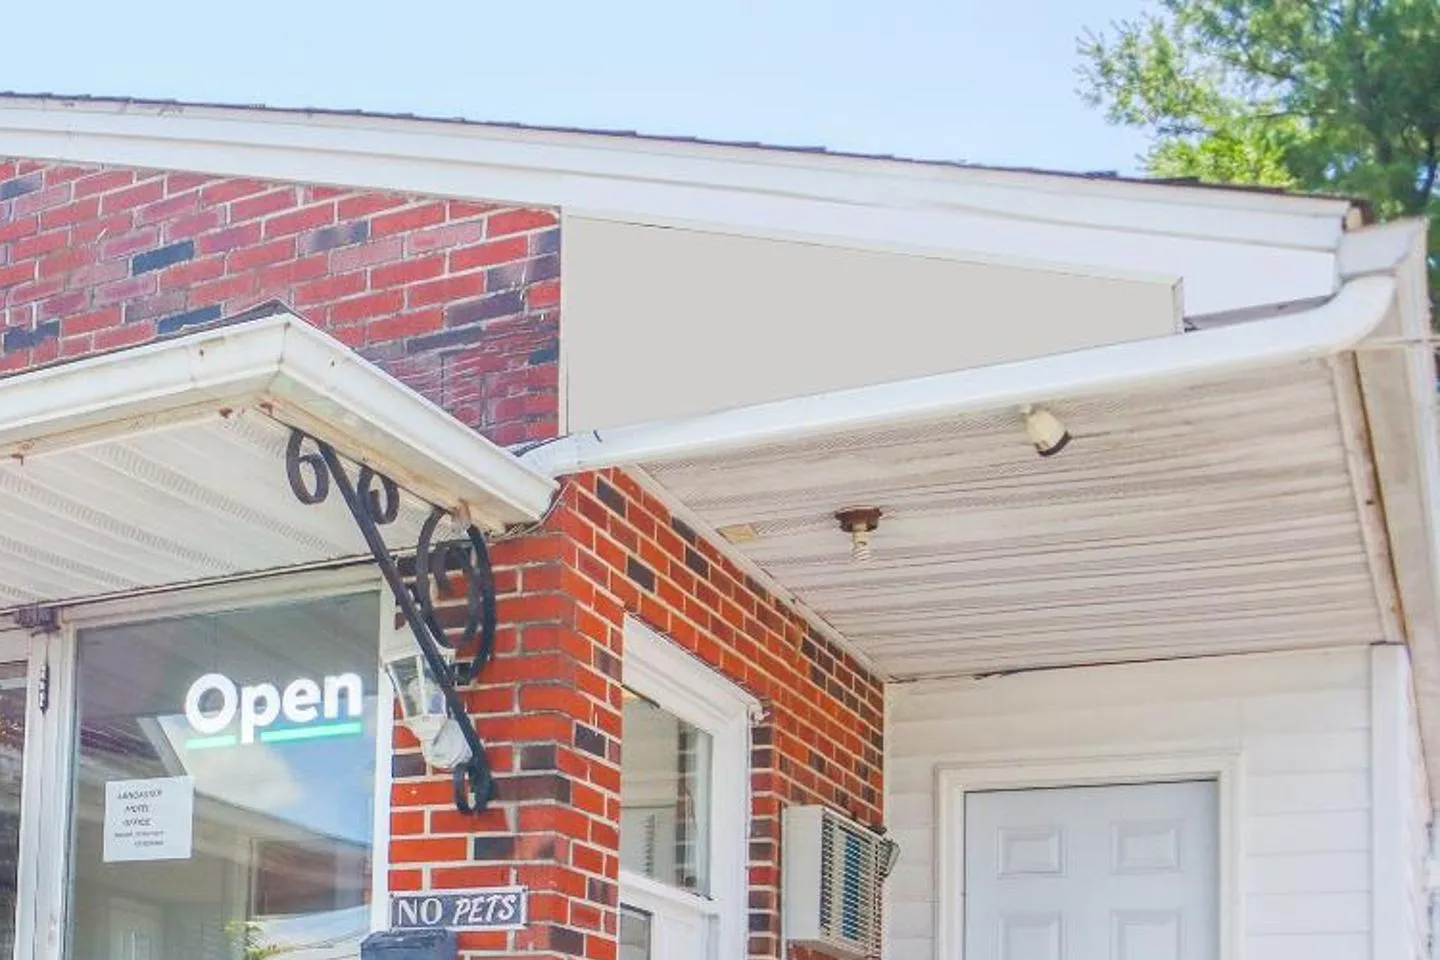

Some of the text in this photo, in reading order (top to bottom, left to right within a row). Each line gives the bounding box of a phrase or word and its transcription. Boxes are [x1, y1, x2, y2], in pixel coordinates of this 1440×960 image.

[185, 673, 363, 744] Open
[398, 894, 517, 925] NO PETS
